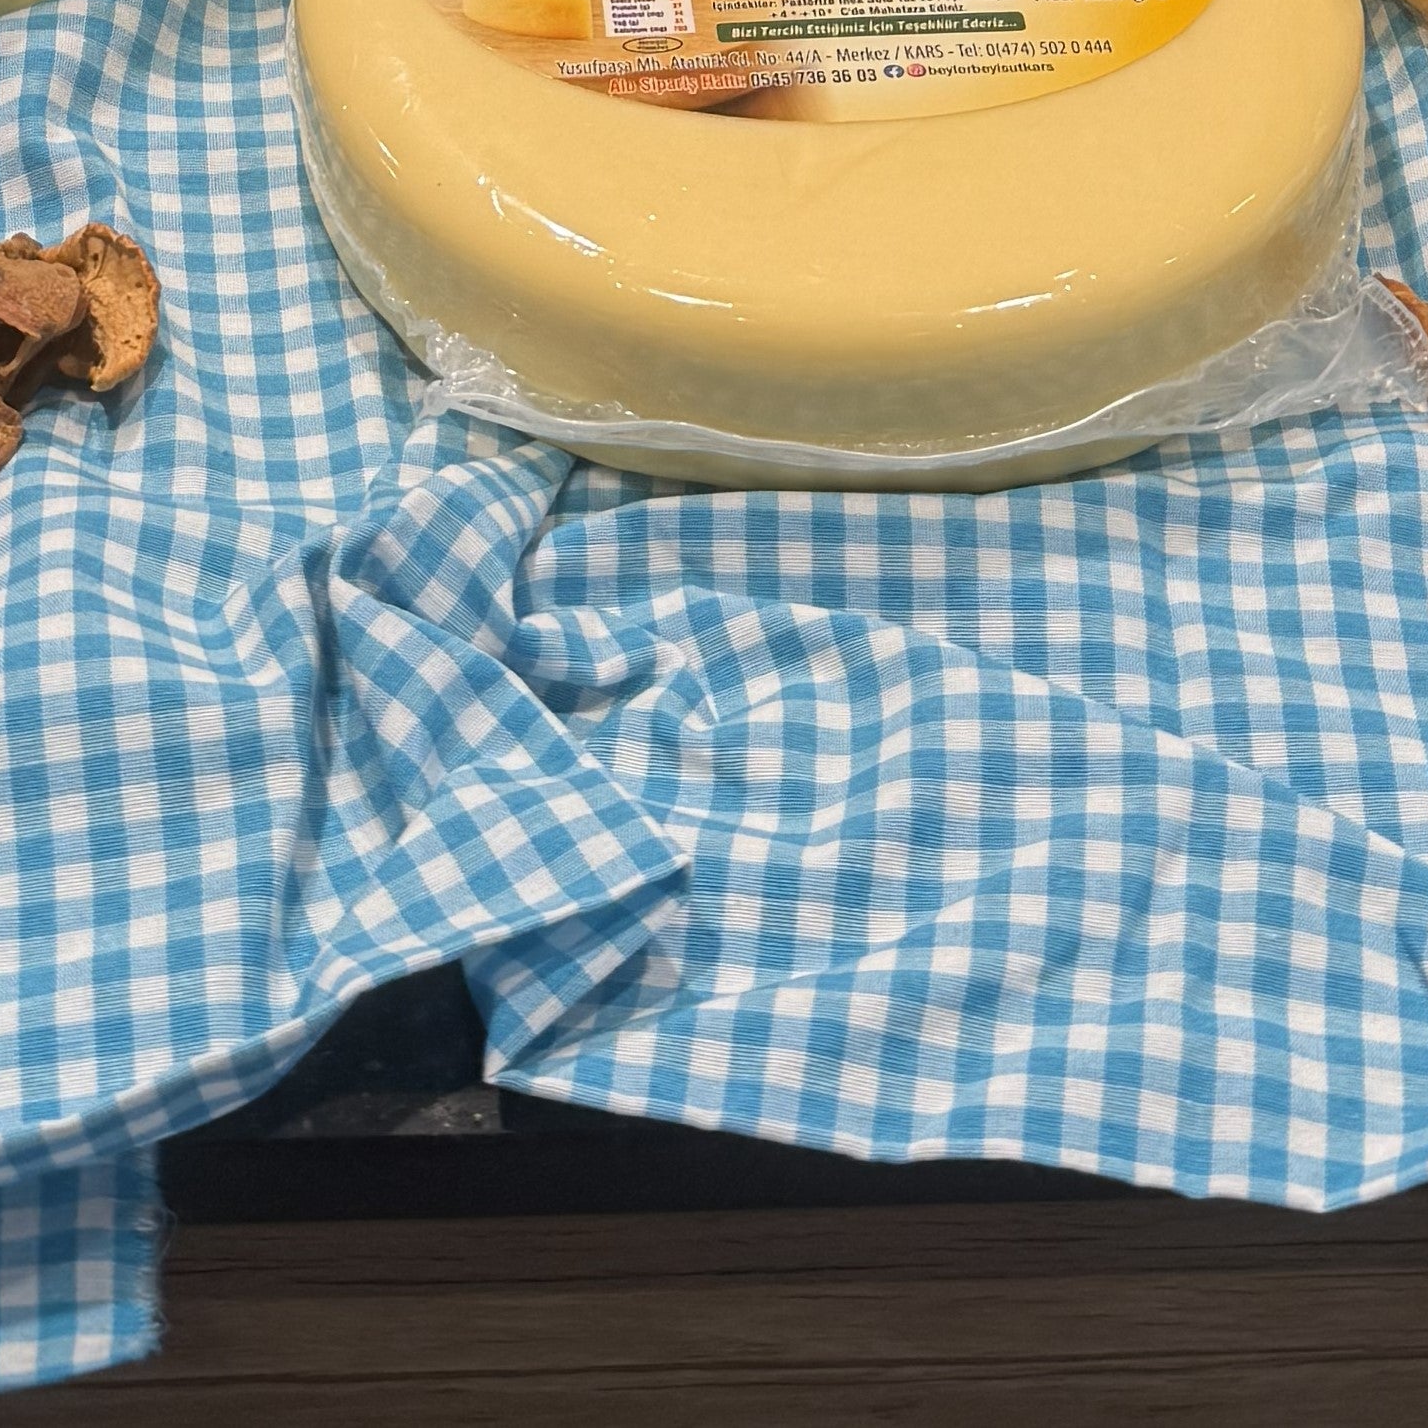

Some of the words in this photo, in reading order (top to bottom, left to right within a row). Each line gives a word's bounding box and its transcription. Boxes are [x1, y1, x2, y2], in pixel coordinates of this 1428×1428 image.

[732, 26, 757, 38] Bizi
[761, 25, 803, 37] Tercih
[807, 21, 864, 36] Ettiğiniz
[869, 17, 893, 34] İçin
[900, 20, 958, 34] Teşekkür
[556, 60, 633, 76] Yusufpaşa
[786, 49, 822, 64] 44/A
[836, 46, 889, 63] Merkez
[904, 44, 944, 59] KARS
[959, 43, 983, 57] Tel:
[987, 42, 1035, 58] 0(474)
[1040, 41, 1066, 55] 502
[1072, 42, 1079, 54] 0
[1084, 40, 1112, 54] 444
[751, 71, 790, 88] 0545
[797, 70, 826, 85] 736
[832, 70, 851, 83] 36
[857, 69, 877, 83] 03
